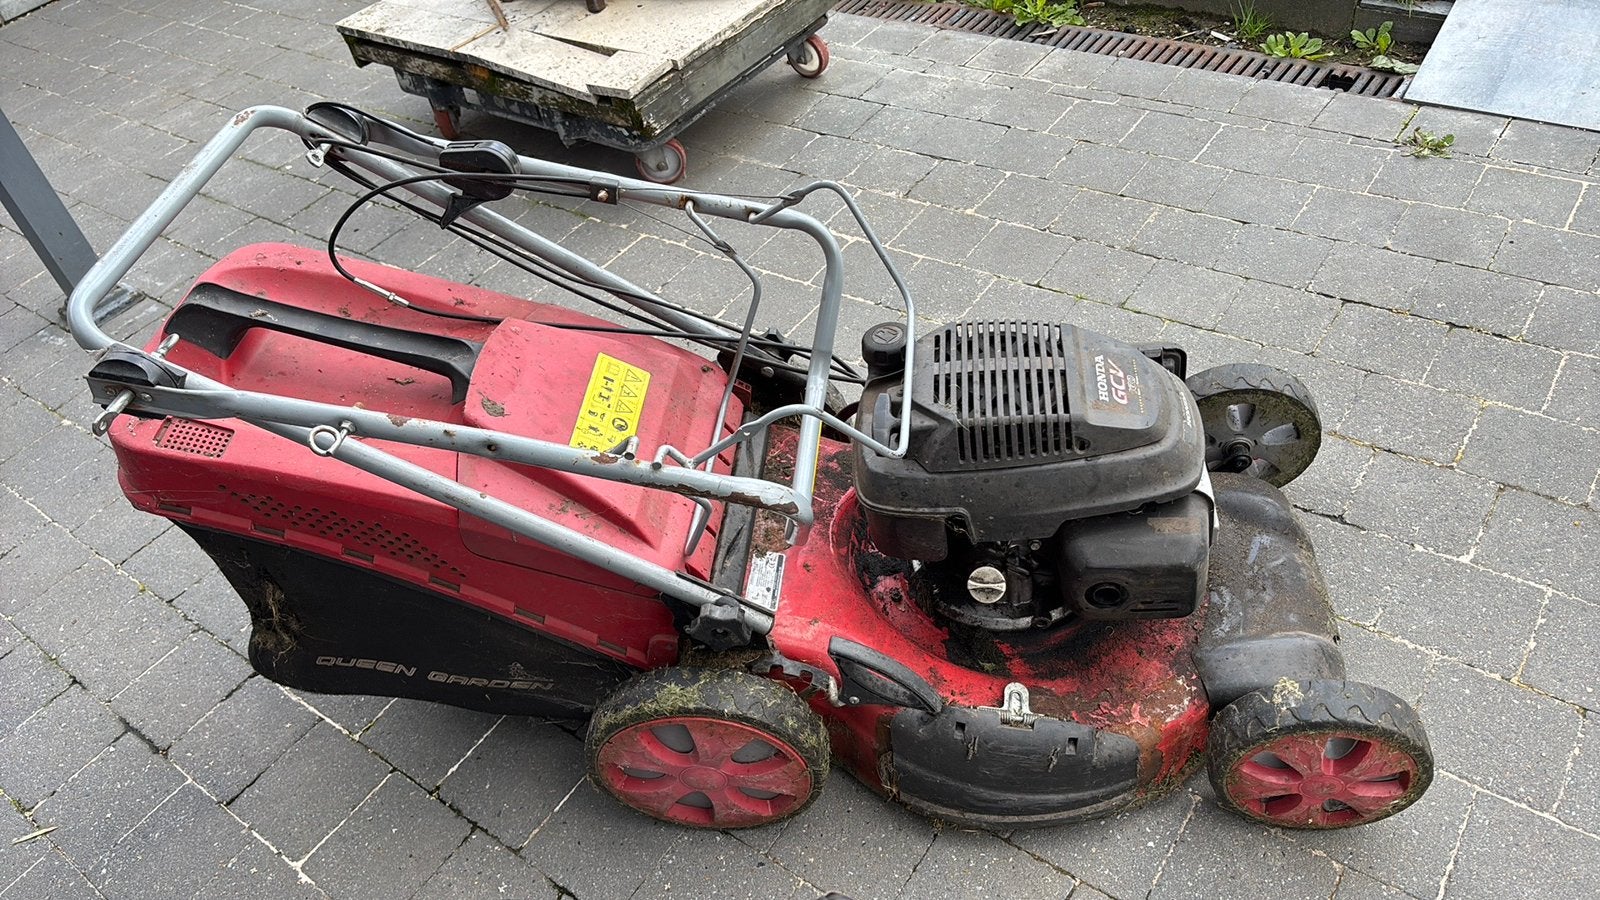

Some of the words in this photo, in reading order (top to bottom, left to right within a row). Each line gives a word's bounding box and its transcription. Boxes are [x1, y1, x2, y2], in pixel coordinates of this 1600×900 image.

[1094, 354, 1109, 402] HONDA
[1107, 358, 1128, 404] GCV
[315, 656, 417, 677] QUEEN
[427, 670, 554, 690] GARDEN
